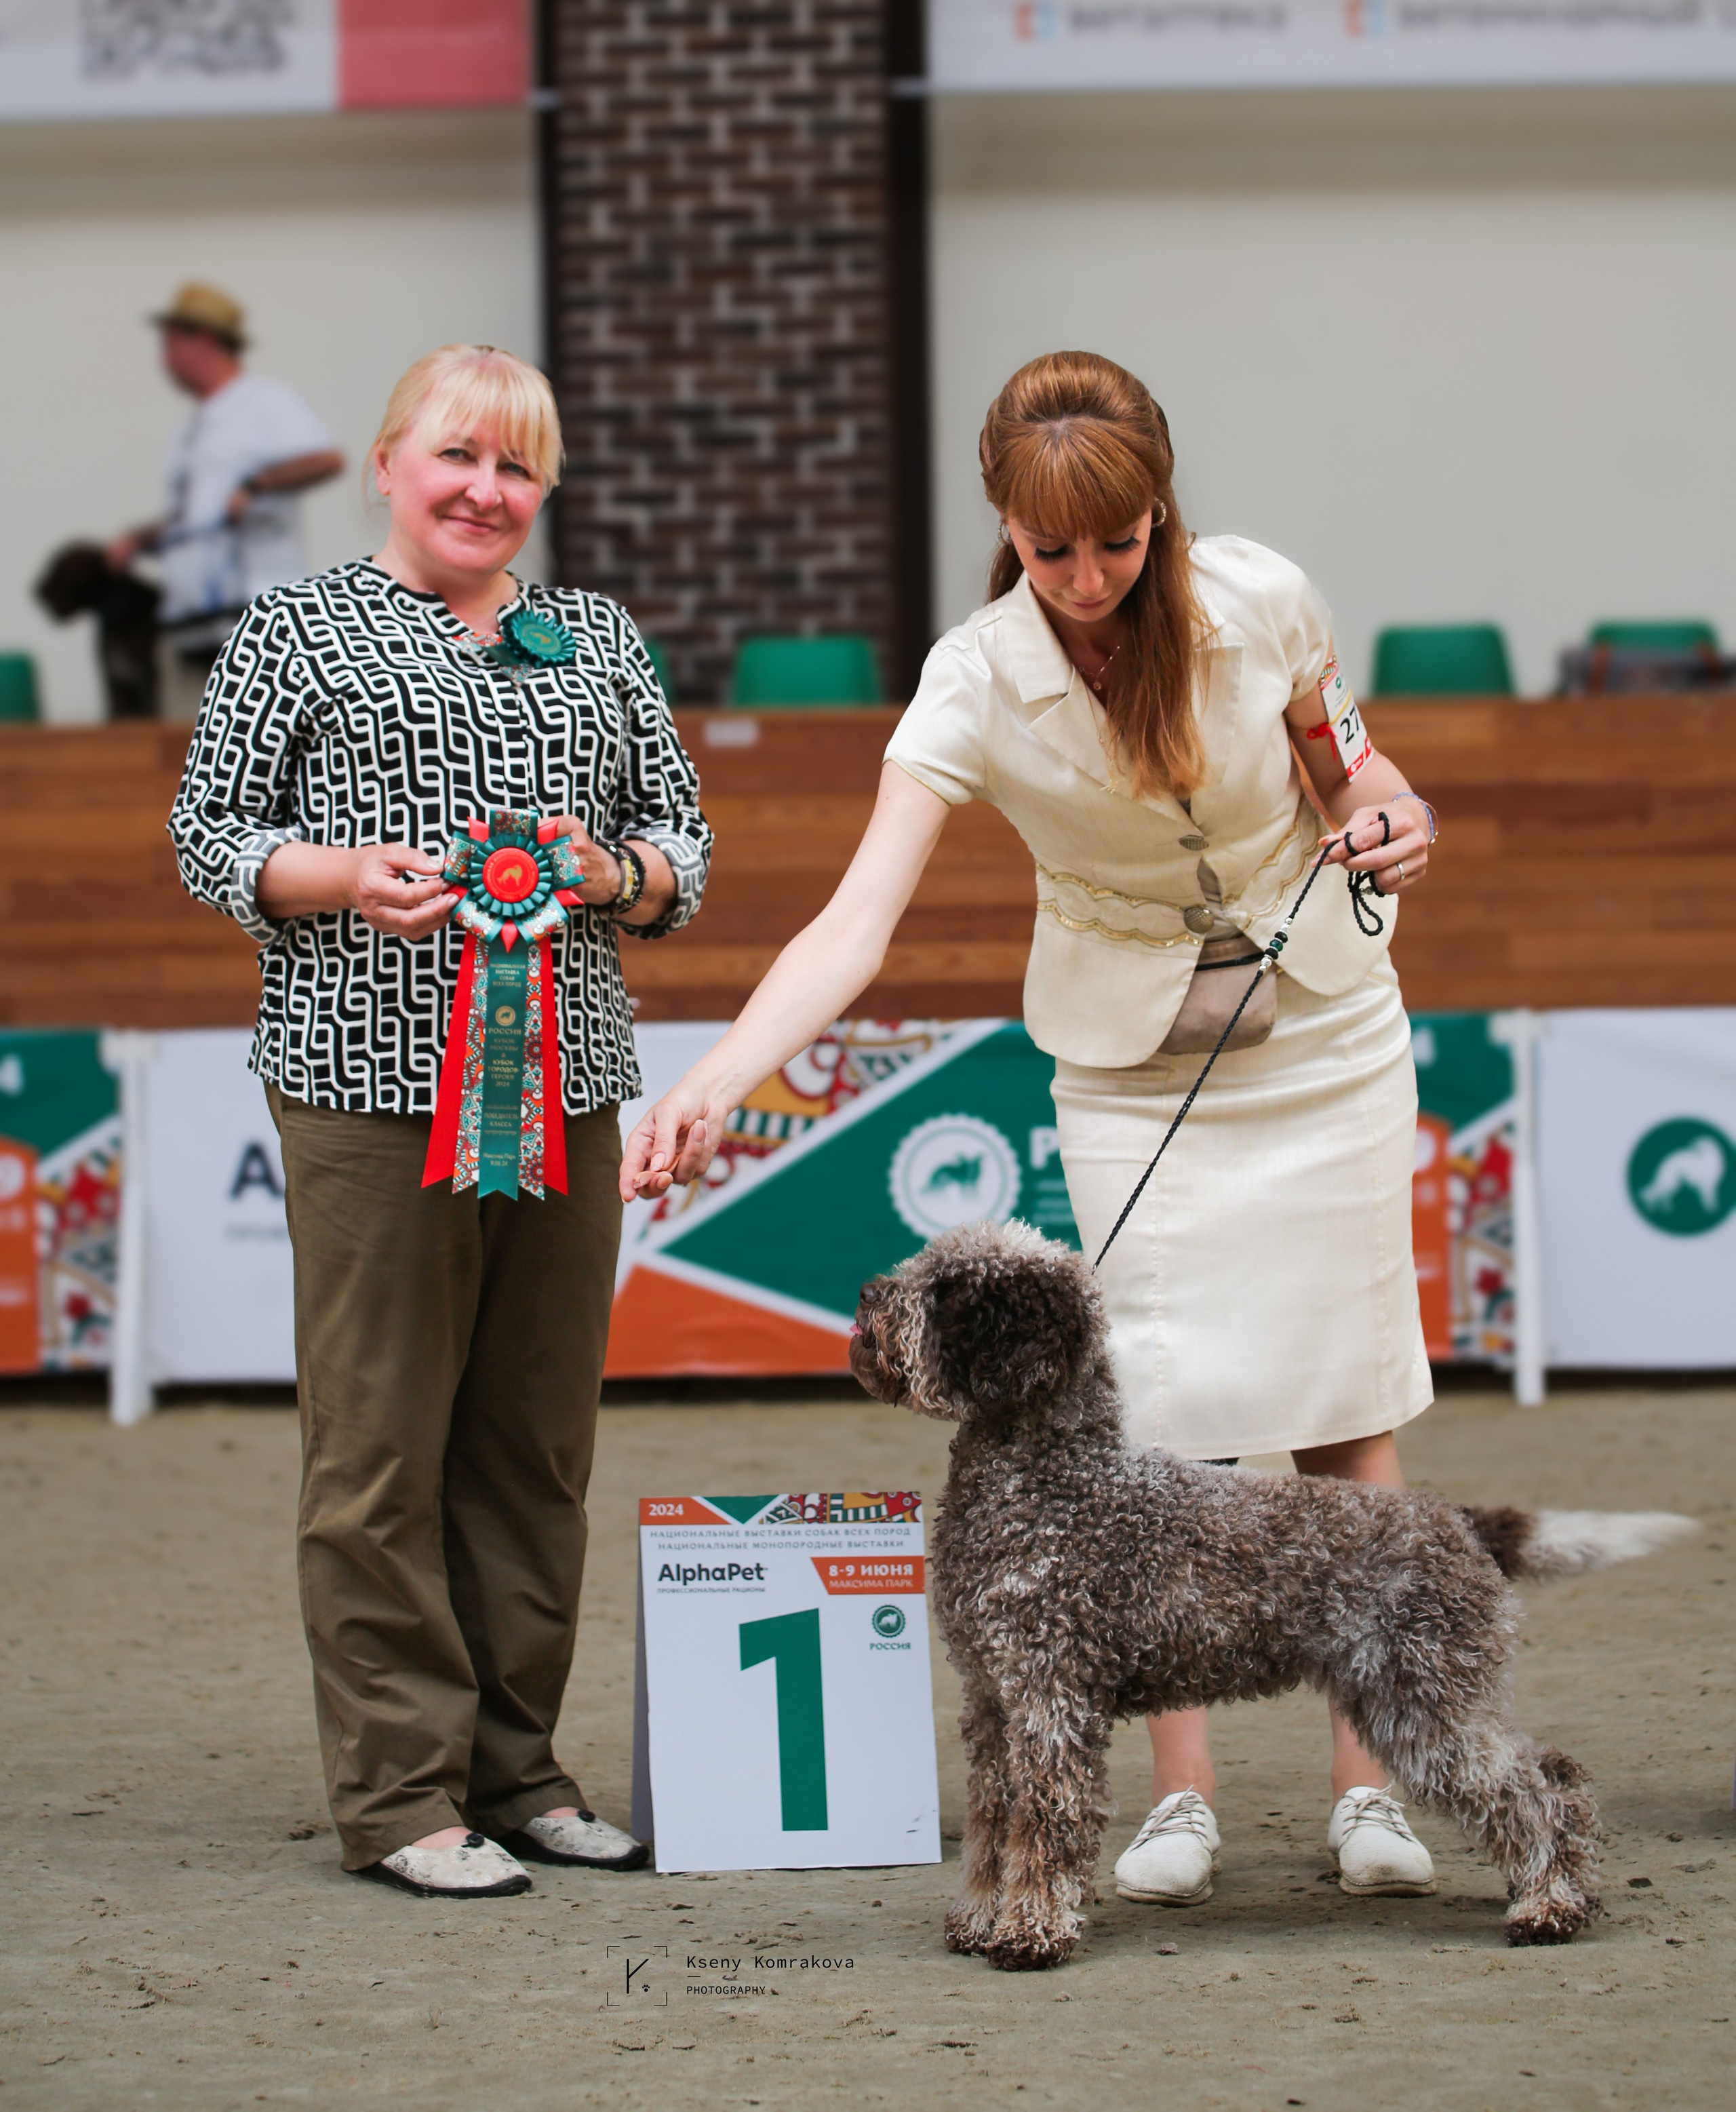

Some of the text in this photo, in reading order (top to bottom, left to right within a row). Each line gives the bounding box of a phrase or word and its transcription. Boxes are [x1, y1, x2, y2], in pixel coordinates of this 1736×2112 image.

[1340, 706, 1359, 744] 27
[648, 1503, 684, 1517] 2024
[650, 1527, 911, 1539] НАЦИОНАЛЬНЫЕ ВЫСТАВКИ СОБАК ВСЕХ ПОРОД
[658, 1540, 904, 1550] НАЦИОНАЛЬНЫЕ МОНОПОРОДНЫЕ ВЫСТАВКИ
[658, 1563, 765, 1586] AlphaPet
[828, 1563, 914, 1577] 8-9 ИЮНЯ
[829, 1579, 913, 1588] МАКСИМА ПАРК
[869, 1641, 911, 1651] РОССИЯ
[739, 1608, 828, 1831] 1
